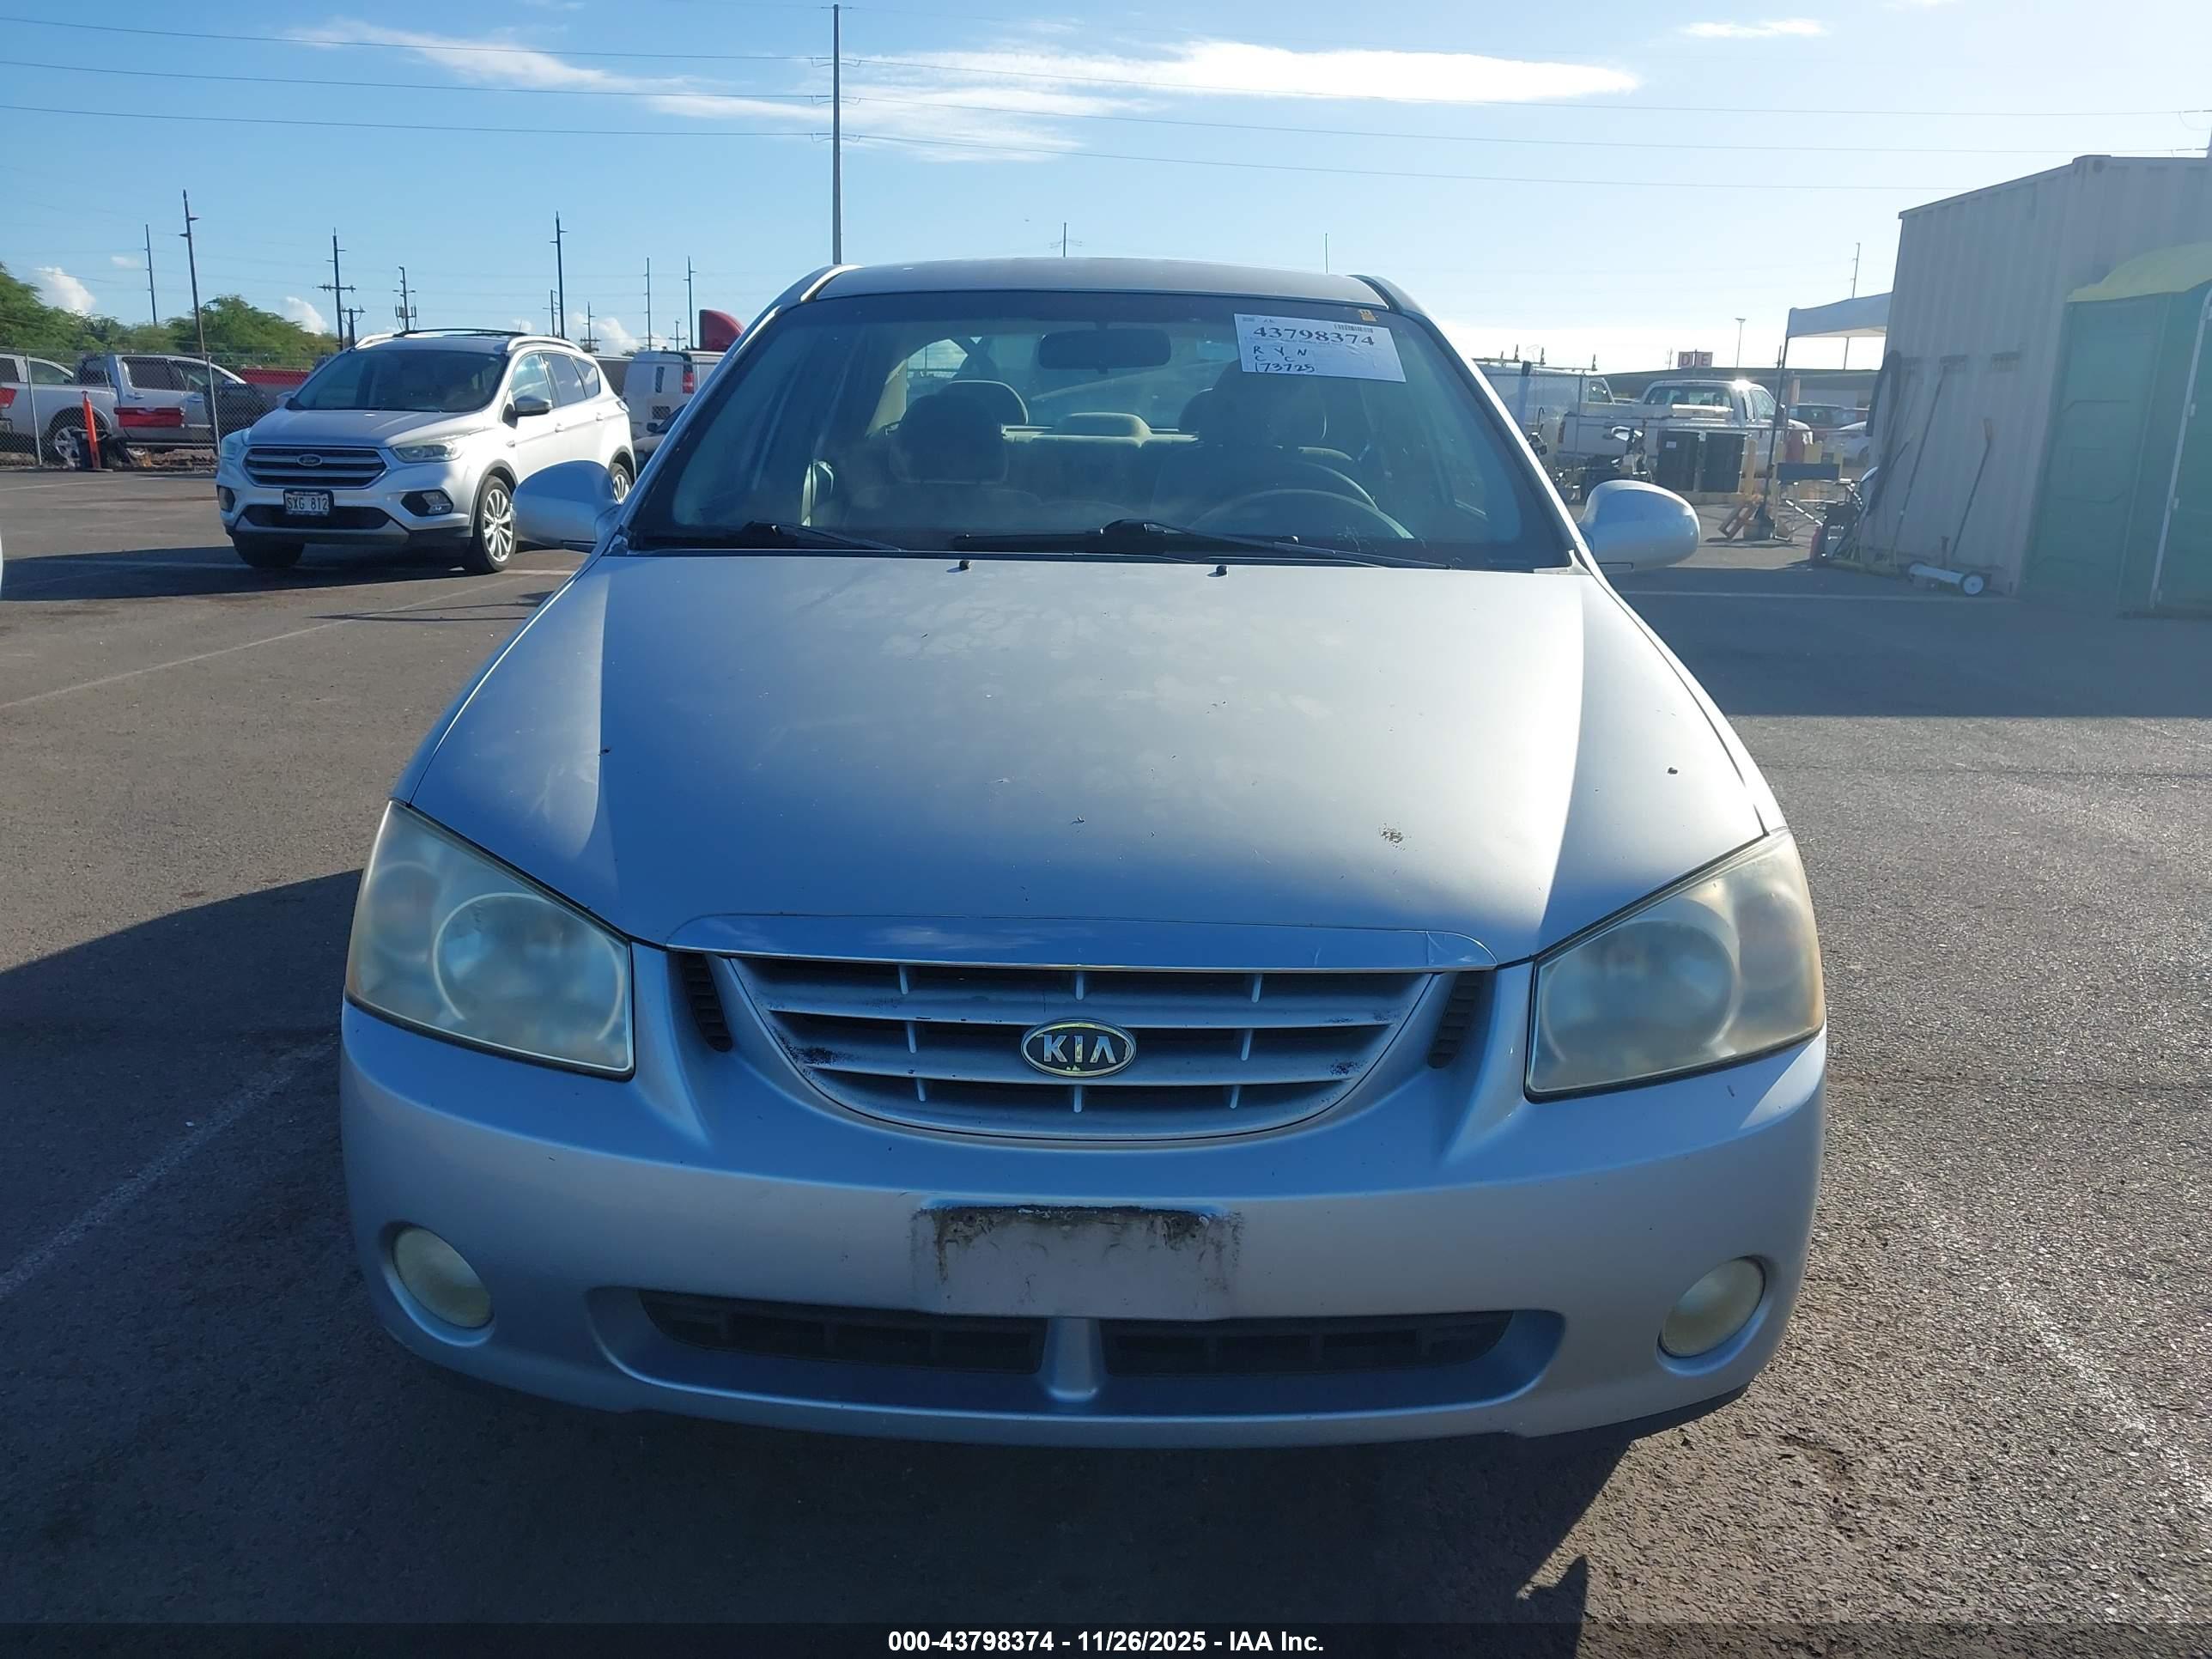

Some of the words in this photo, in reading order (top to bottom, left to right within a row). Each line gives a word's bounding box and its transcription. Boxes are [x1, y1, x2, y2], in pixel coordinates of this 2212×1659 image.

[1254, 326, 1374, 345] 43798374
[1254, 345, 1264, 355] R
[1297, 348, 1307, 356] N
[287, 497, 305, 510] SXG
[310, 497, 327, 510] 812
[1043, 1034, 1116, 1064] KIA
